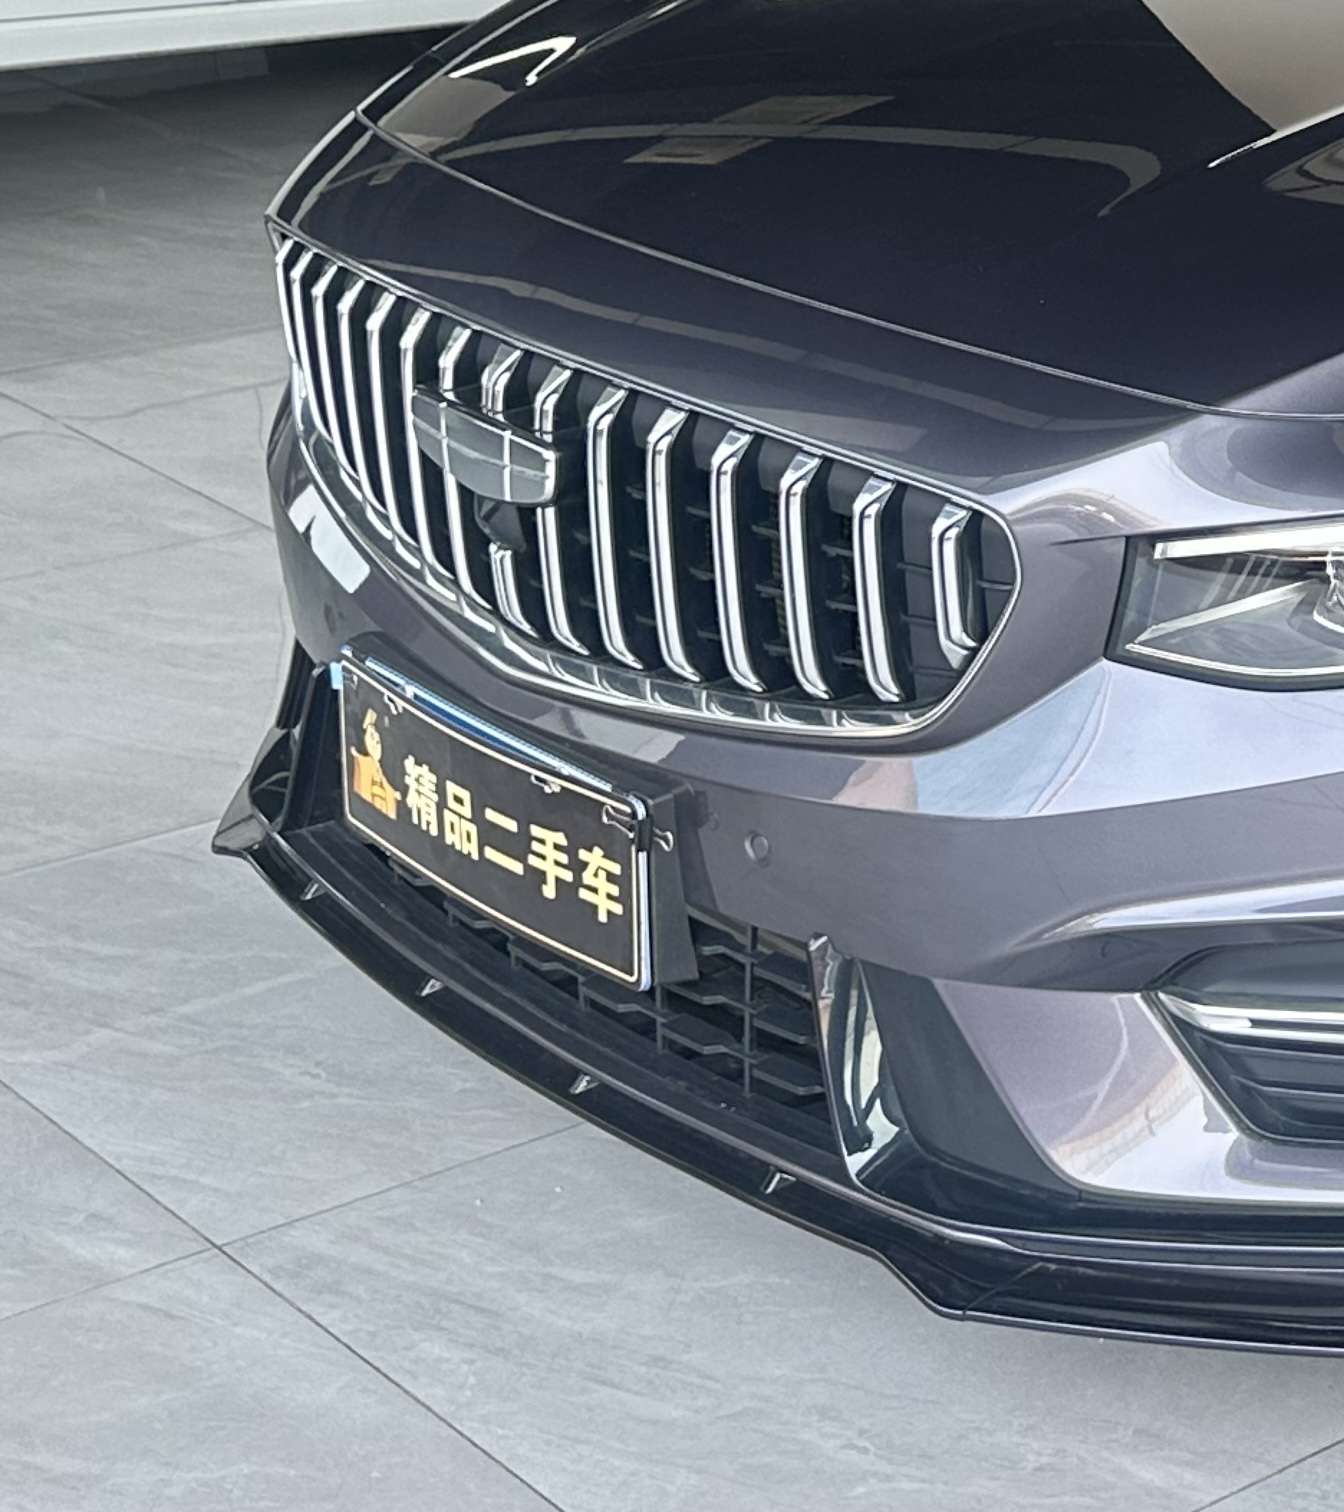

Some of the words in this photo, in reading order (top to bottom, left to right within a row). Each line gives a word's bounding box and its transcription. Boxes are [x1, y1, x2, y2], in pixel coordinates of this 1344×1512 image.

[404, 755, 624, 923] 精品二手车
